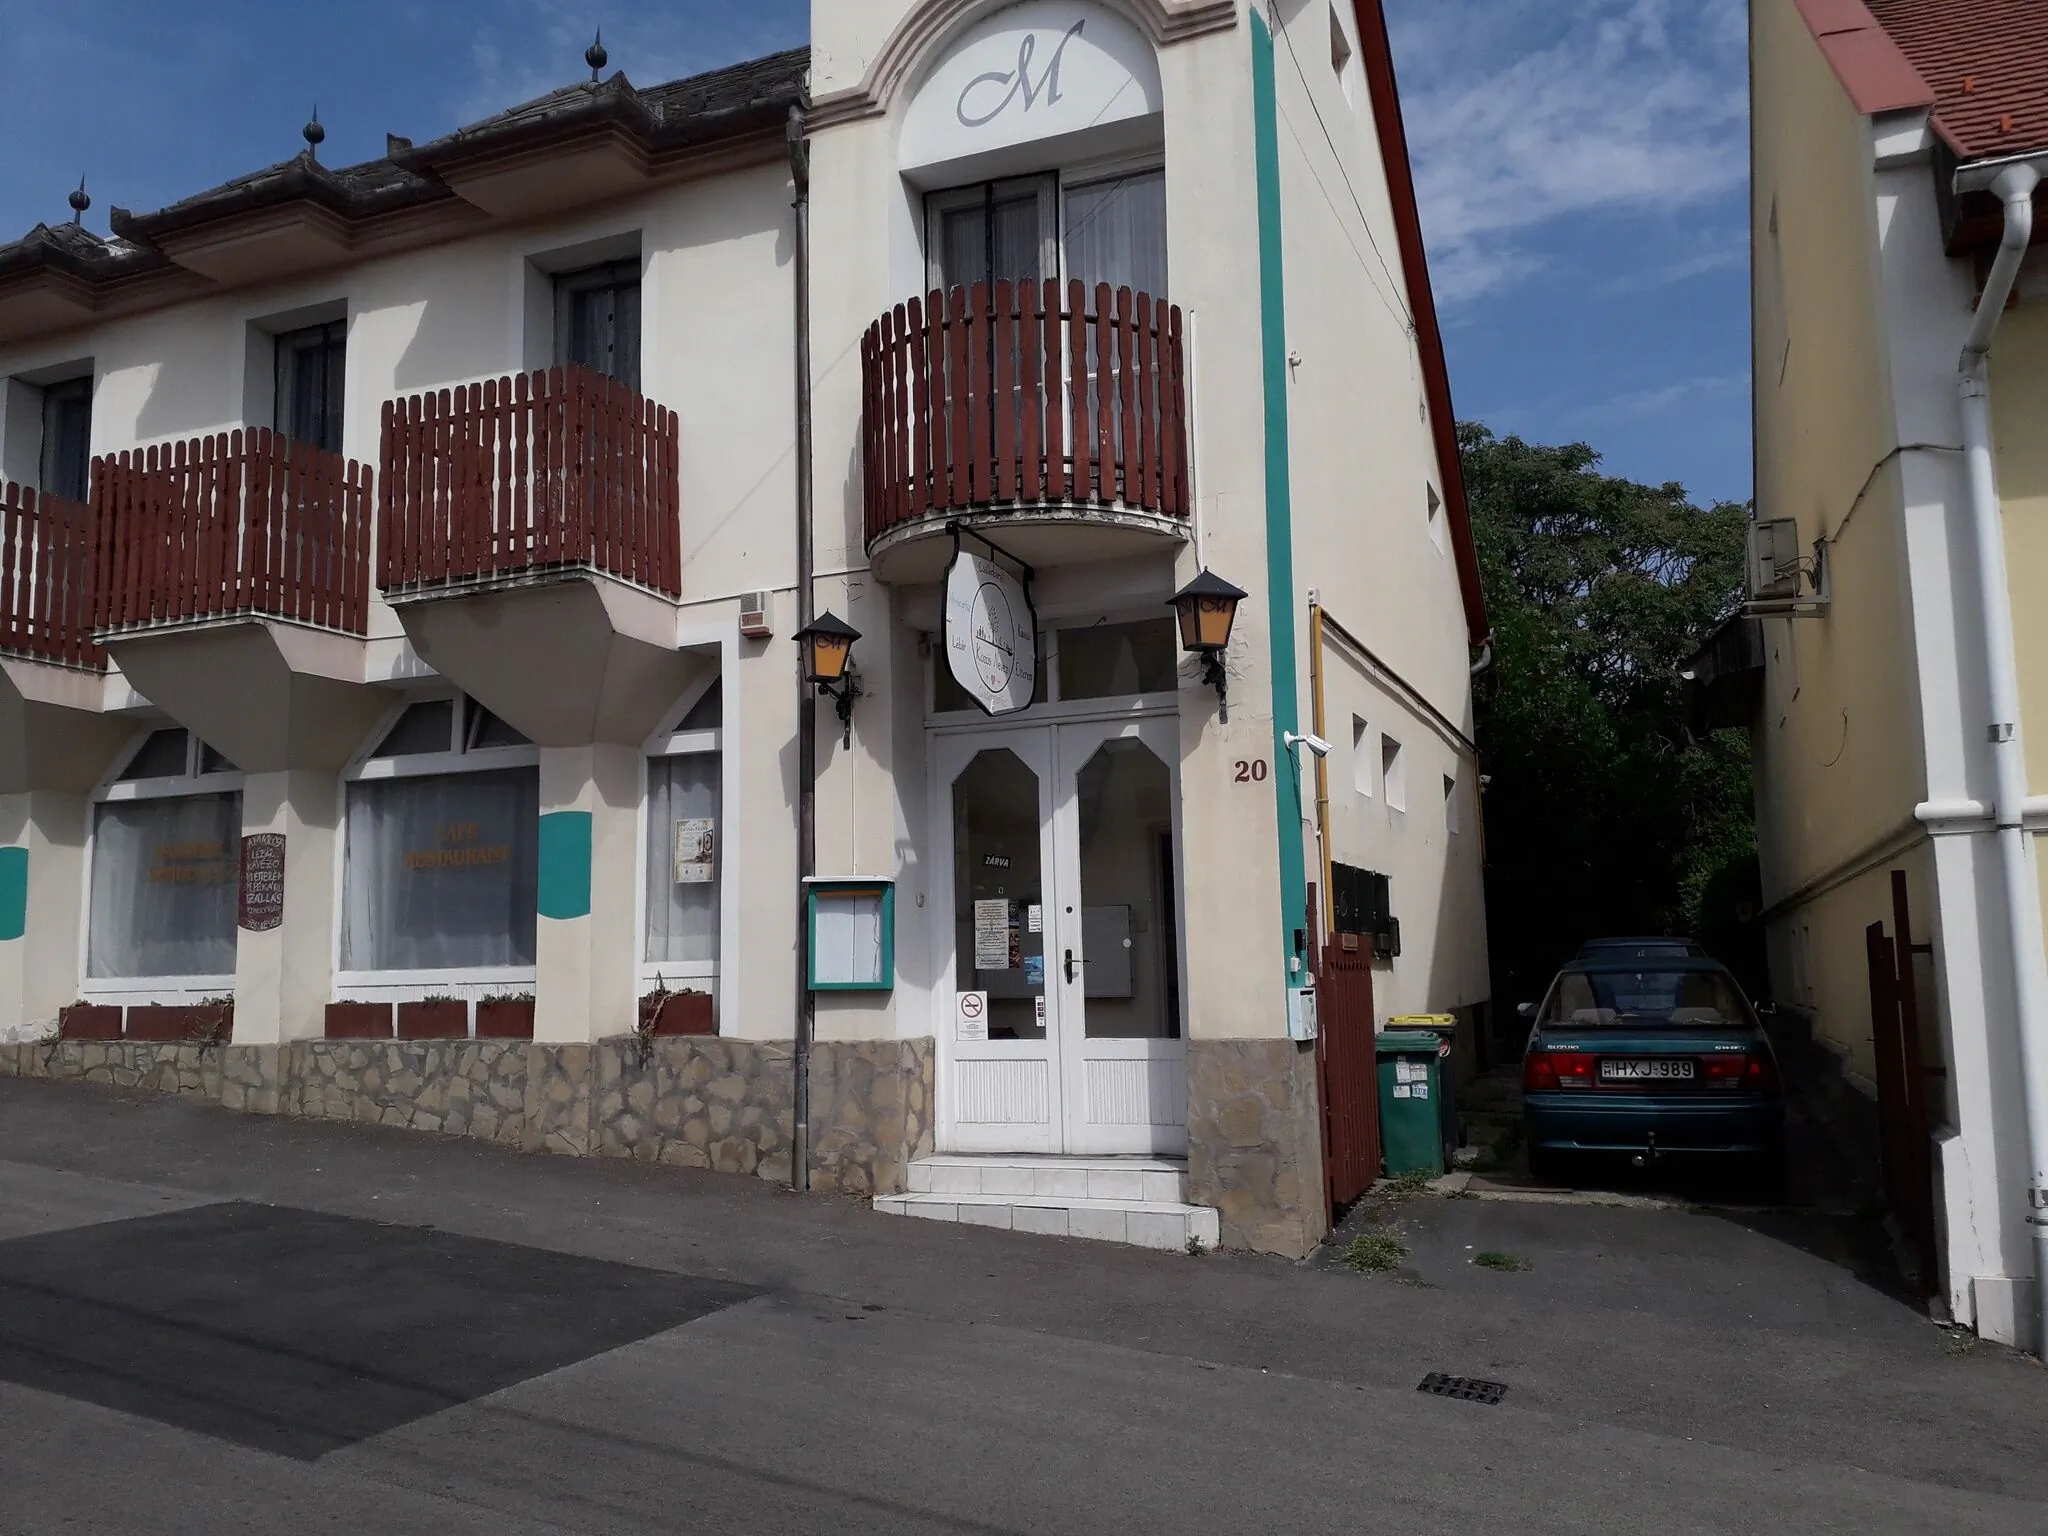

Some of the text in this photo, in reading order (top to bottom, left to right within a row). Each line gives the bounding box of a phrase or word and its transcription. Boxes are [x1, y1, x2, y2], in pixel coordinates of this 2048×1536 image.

[956, 19, 1086, 128] M
[1235, 759, 1268, 782] 20
[985, 856, 1009, 868] ZÁRVA
